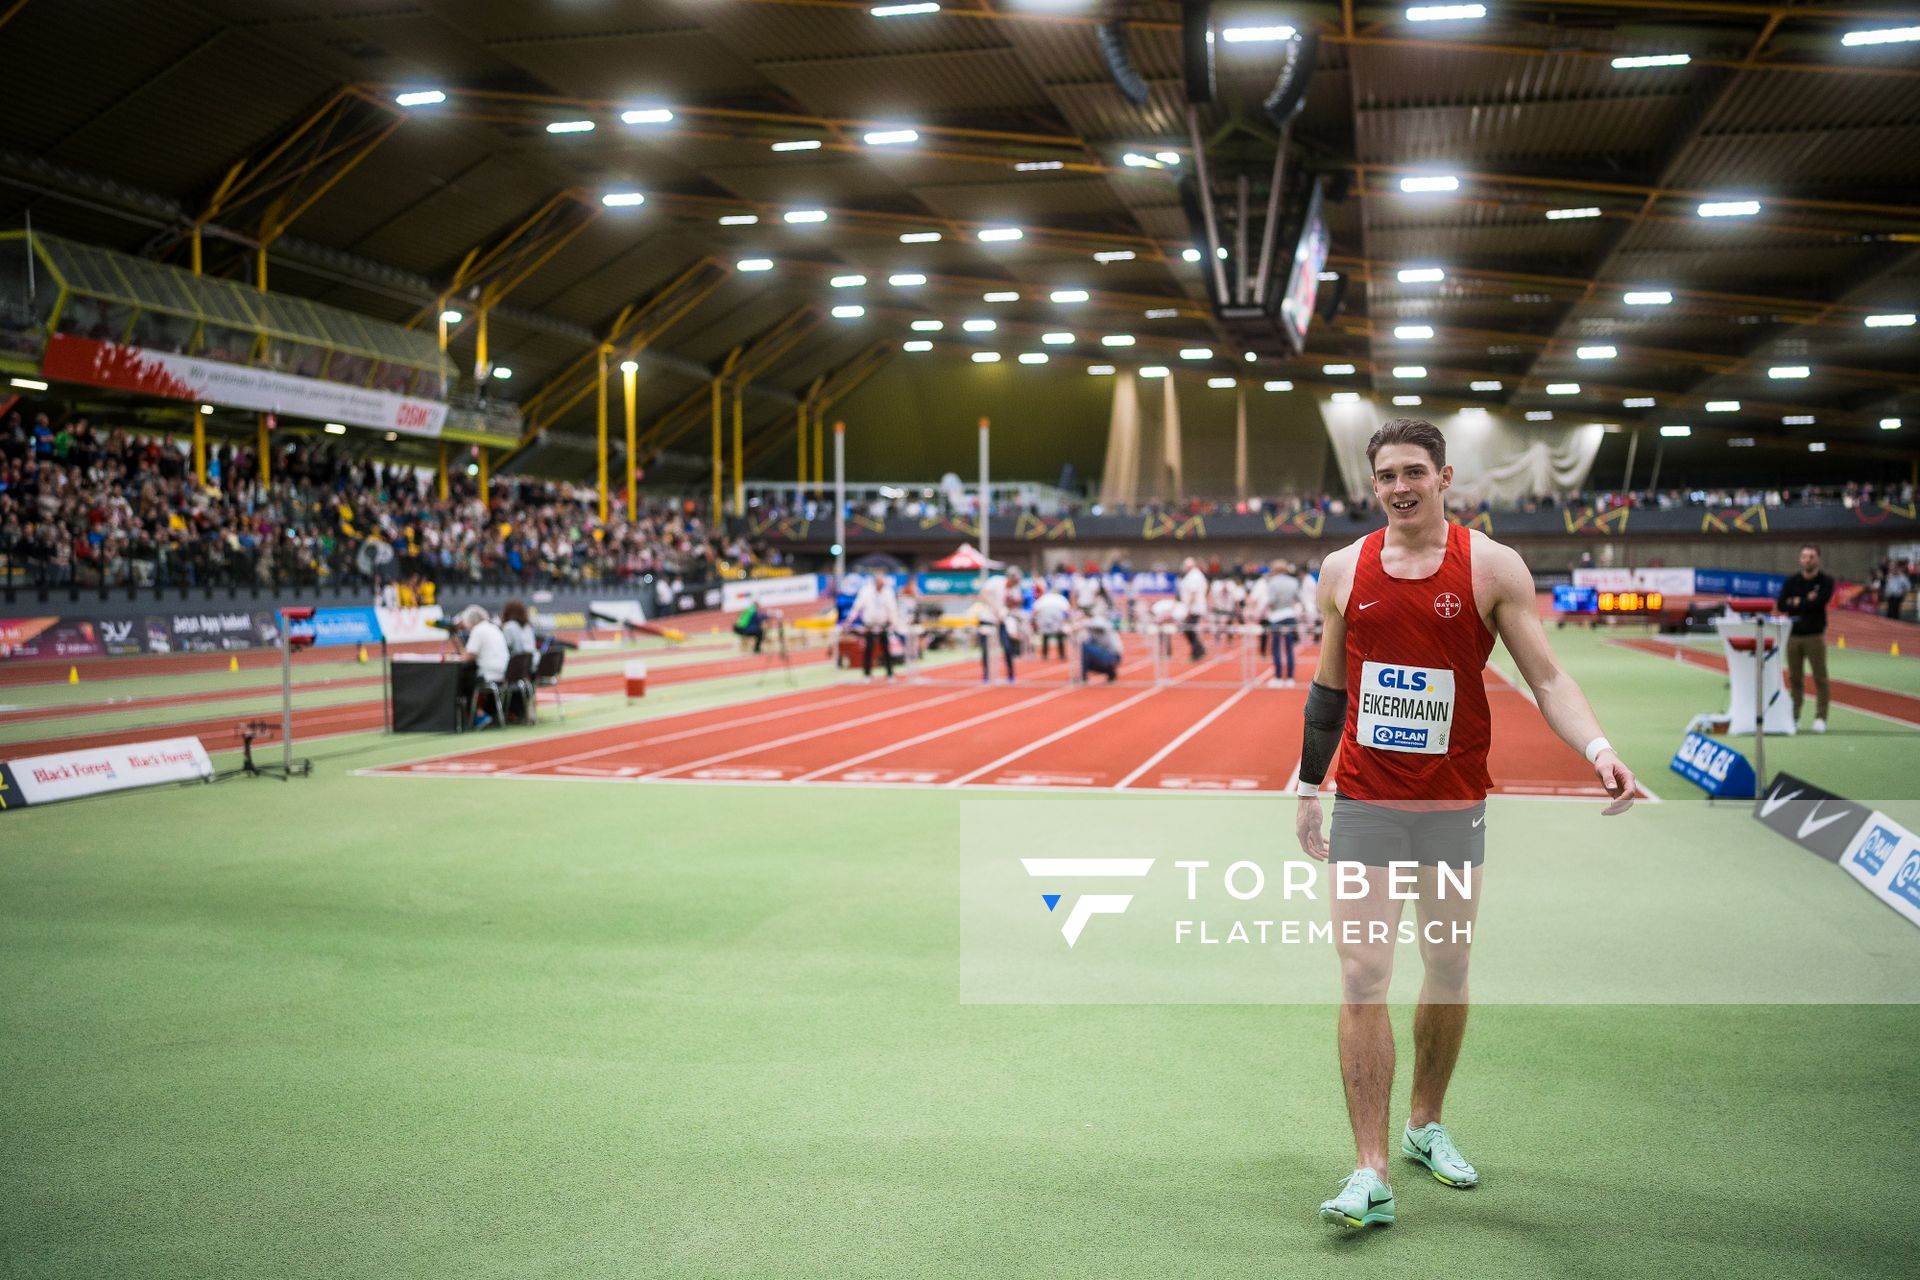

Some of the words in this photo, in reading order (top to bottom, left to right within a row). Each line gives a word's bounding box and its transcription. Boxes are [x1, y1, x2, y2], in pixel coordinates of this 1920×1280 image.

[1362, 692, 1450, 722] EIKERMANN
[1394, 730, 1426, 742] PLAN
[32, 764, 73, 784] Black
[73, 760, 113, 777] Forest
